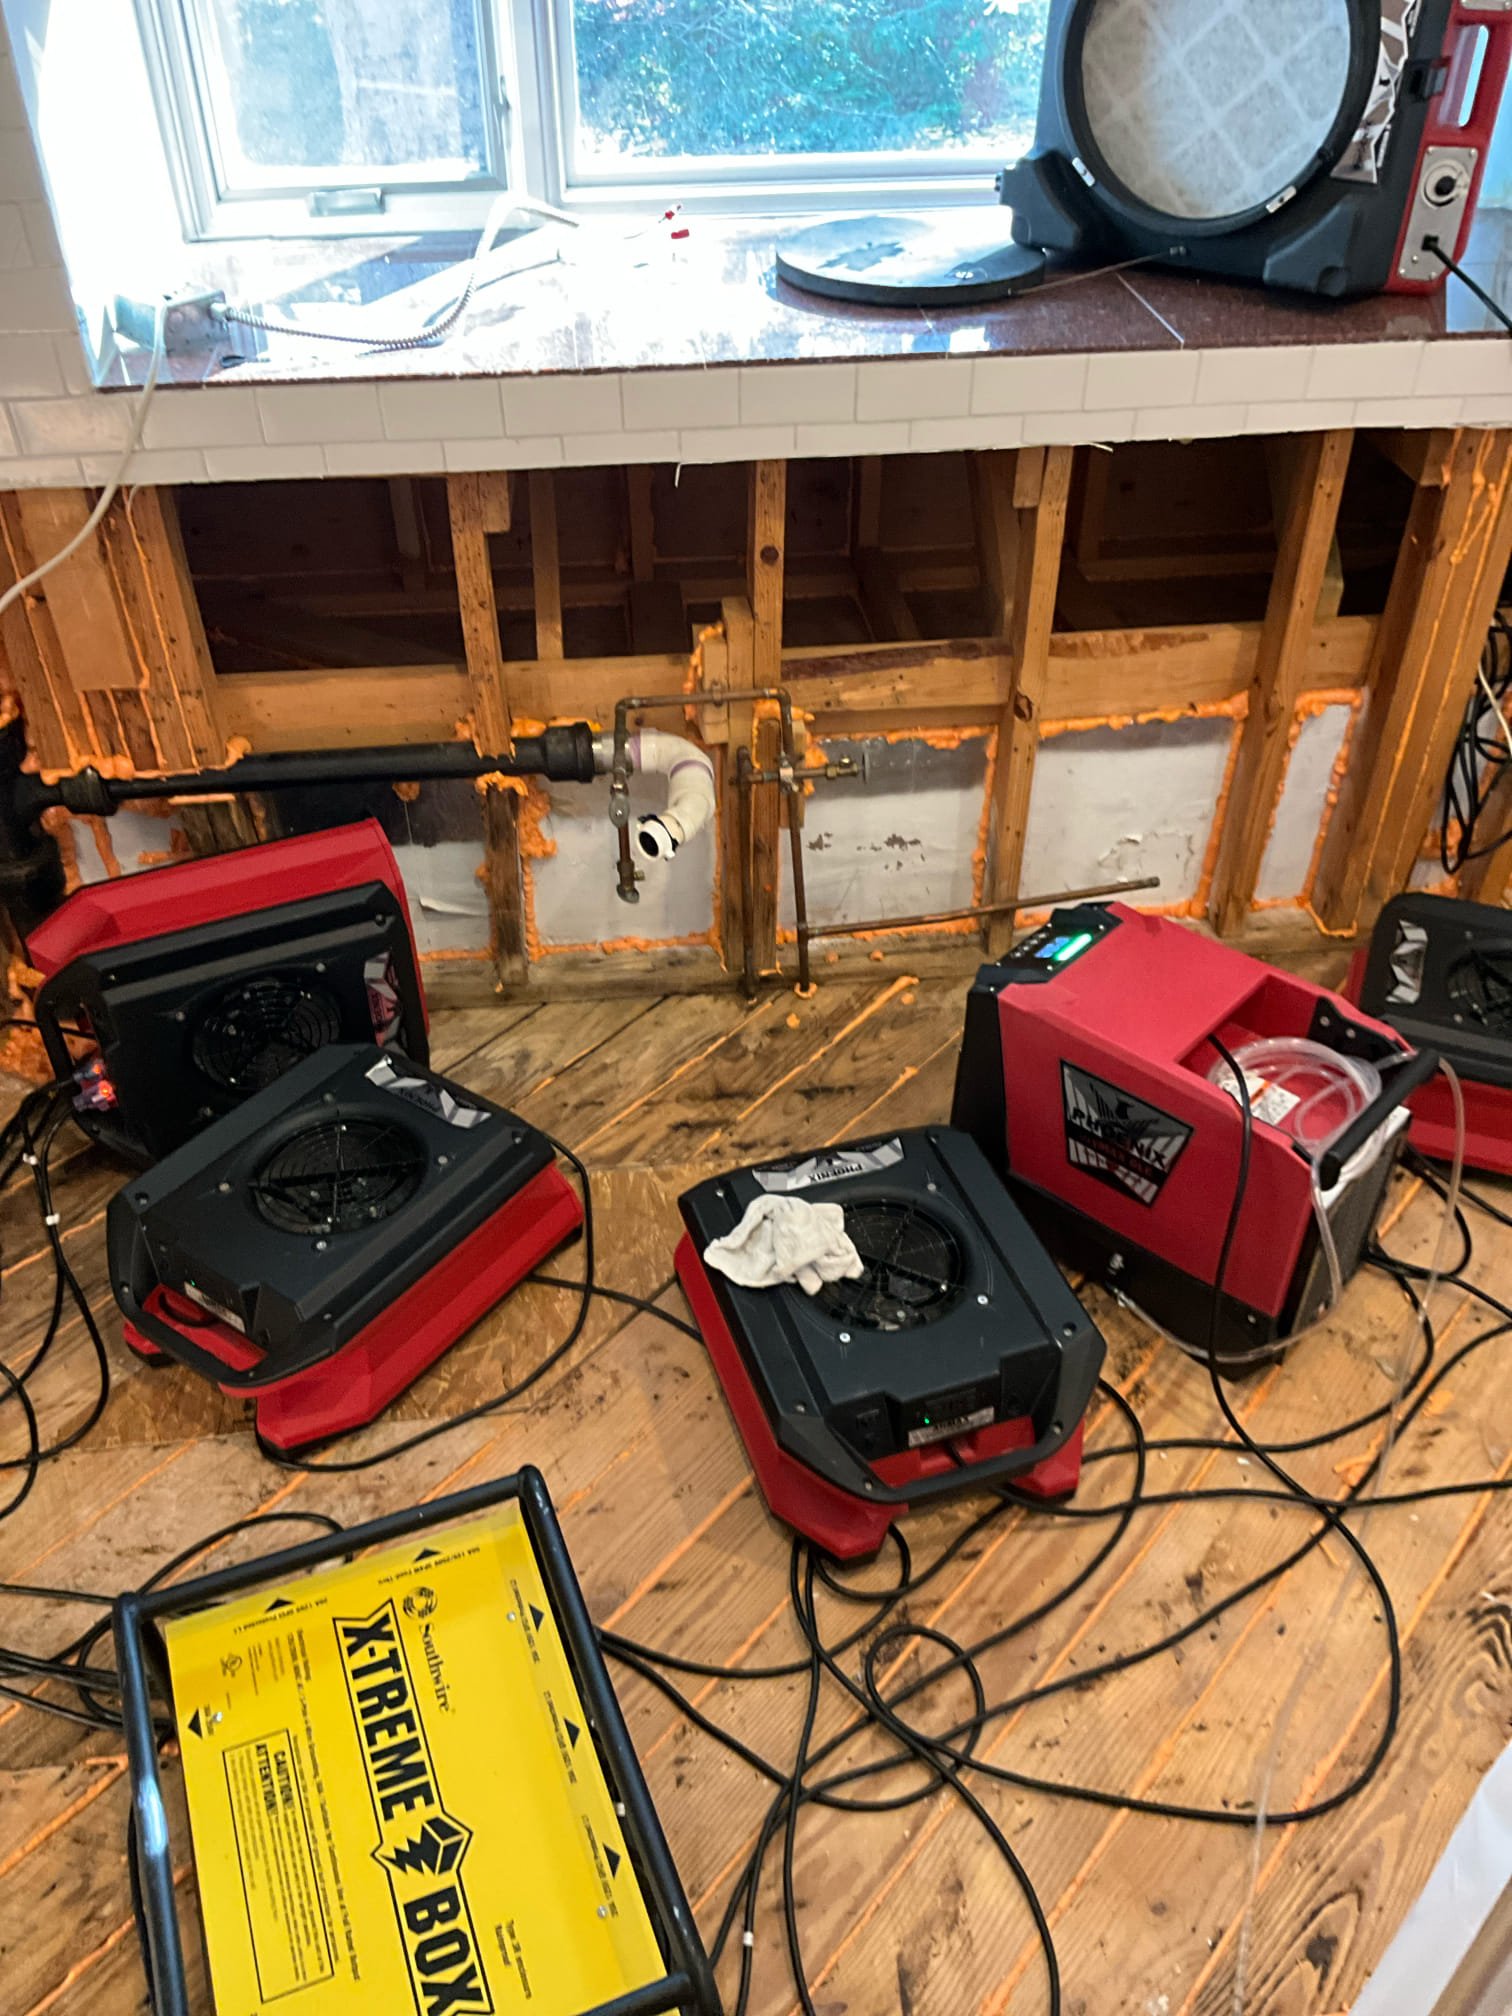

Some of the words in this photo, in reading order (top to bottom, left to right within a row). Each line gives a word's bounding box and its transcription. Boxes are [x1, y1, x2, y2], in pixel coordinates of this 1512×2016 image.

[807, 1162, 863, 1183] PHOENIX
[1072, 1107, 1167, 1169] PHOENIX
[419, 1622, 453, 1713] Southwire
[342, 1613, 435, 1822] X-TREME
[403, 1885, 484, 2016] BOX
